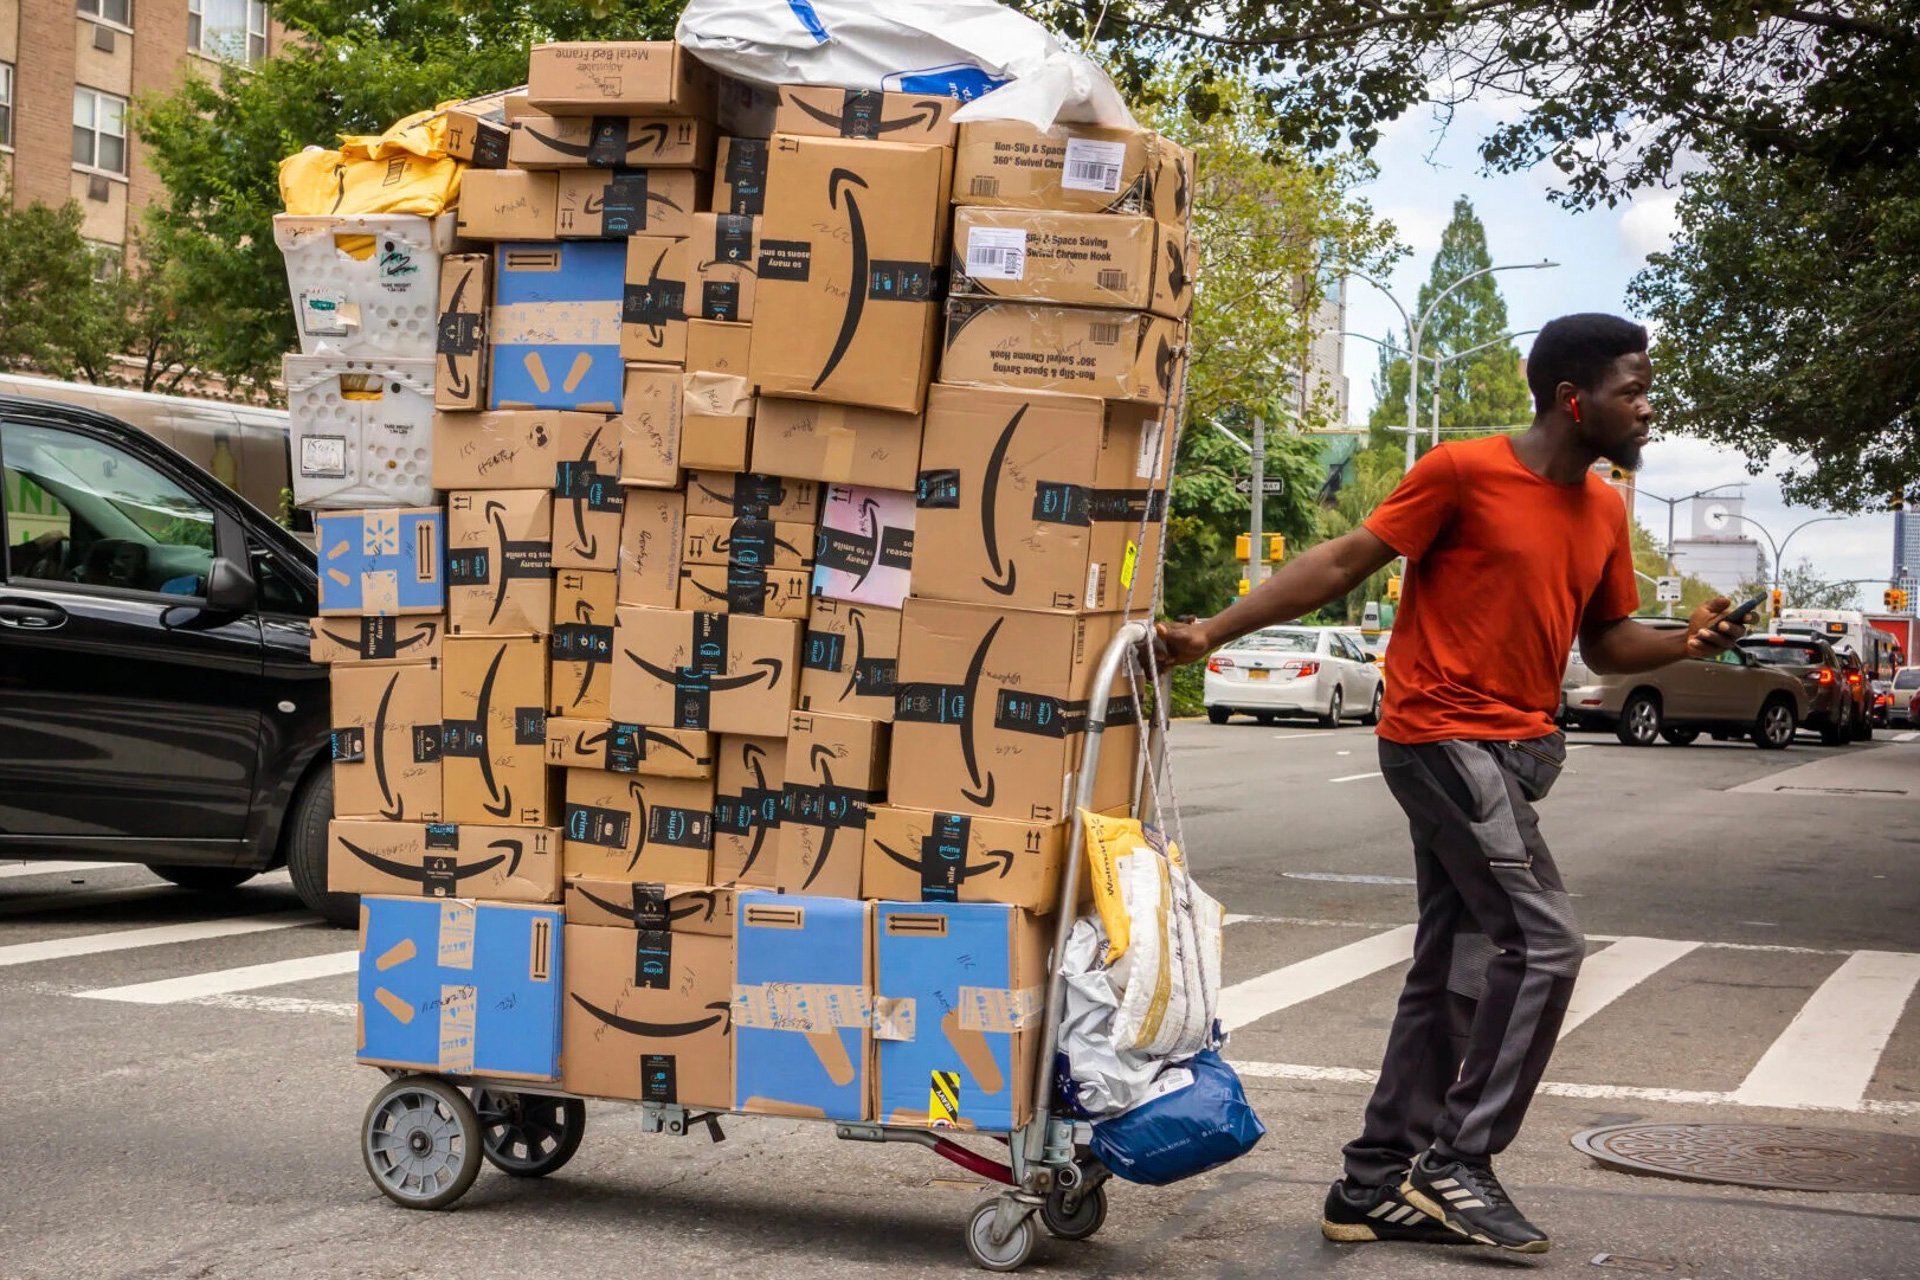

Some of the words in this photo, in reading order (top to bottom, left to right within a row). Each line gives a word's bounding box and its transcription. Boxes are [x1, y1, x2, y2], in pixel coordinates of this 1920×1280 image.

[555, 49, 589, 61] Frame
[592, 49, 613, 61] Bed
[616, 49, 648, 60] Metal
[994, 142, 1030, 154] Non-Slip
[1032, 144, 1038, 154] &
[1014, 156, 1042, 167] Swivel
[1051, 235, 1078, 246] Space
[1079, 236, 1108, 249] Saving
[1056, 249, 1088, 260] Chrome
[1090, 251, 1111, 261] Hook
[768, 258, 791, 268] many
[792, 261, 802, 269] so
[990, 350, 1011, 360] Hook
[1012, 352, 1044, 363] Chrome
[1046, 355, 1074, 366] Swivel
[993, 362, 1021, 375] Saving
[1023, 366, 1048, 378] Space
[1051, 369, 1058, 378] &
[1060, 369, 1095, 381] Non-Slip
[1042, 490, 1051, 513] prime
[832, 541, 855, 553] smile
[856, 547, 865, 556] to
[505, 551, 527, 560] smile
[846, 553, 869, 567] many
[519, 559, 543, 568] many
[369, 622, 375, 632] to
[368, 633, 376, 655] smile
[700, 649, 721, 657] prime
[957, 695, 965, 718] prime
[1037, 702, 1046, 725] prime
[767, 798, 775, 820] prime
[578, 810, 588, 839] prime
[667, 810, 677, 840] prime
[939, 844, 960, 853] prime
[643, 966, 664, 975] prime
[936, 1089, 953, 1113] HEAVY
